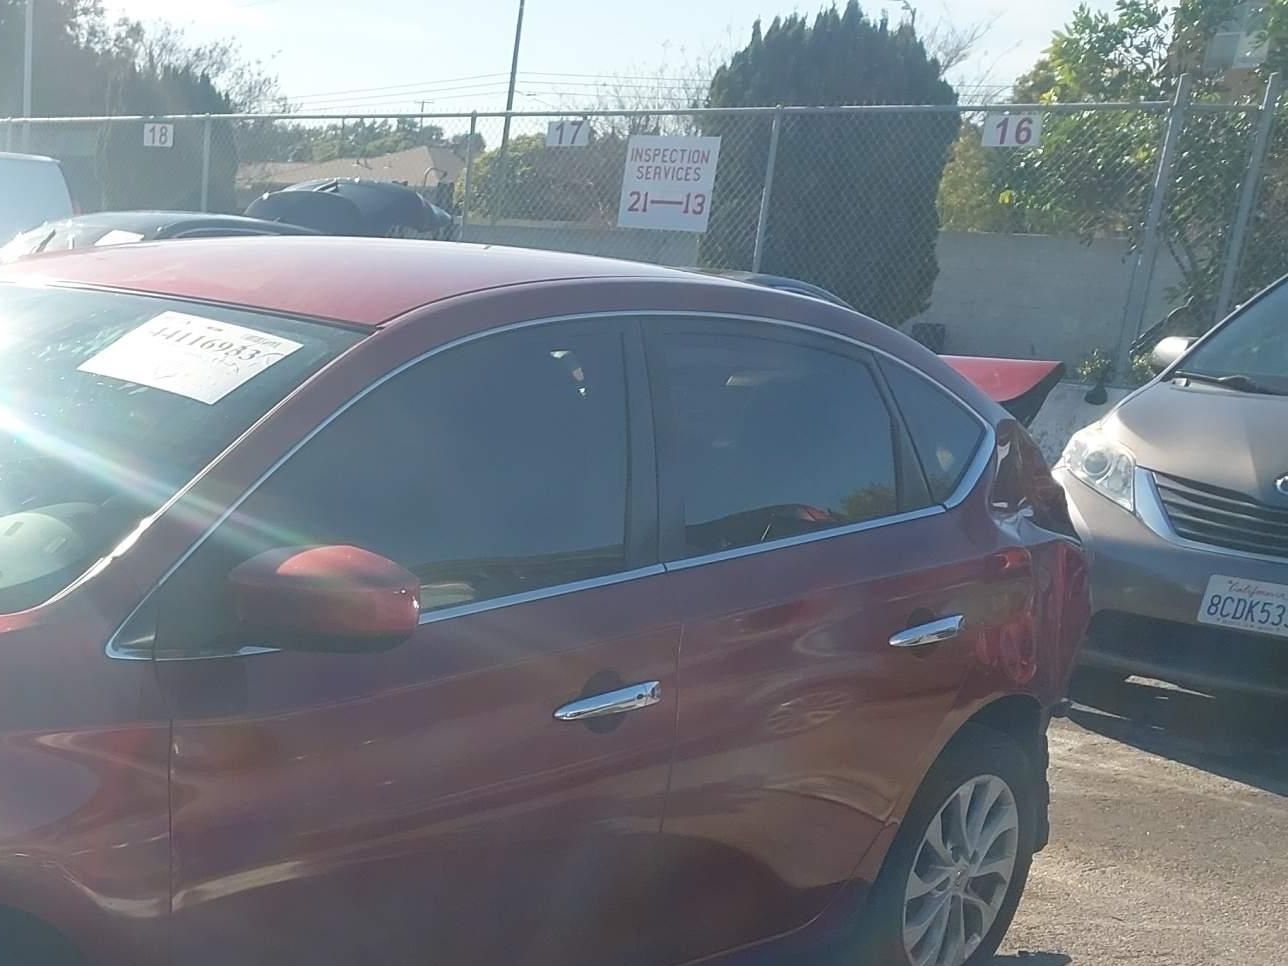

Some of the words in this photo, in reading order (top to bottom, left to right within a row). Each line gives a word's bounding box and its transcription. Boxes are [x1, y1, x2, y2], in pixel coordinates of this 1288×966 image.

[149, 125, 168, 145] 18
[555, 120, 584, 145] 17
[996, 117, 1034, 145] 16
[631, 147, 711, 165] INSPECTION
[635, 165, 702, 182] SERVICES
[1206, 594, 1288, 628] 8CDK53
